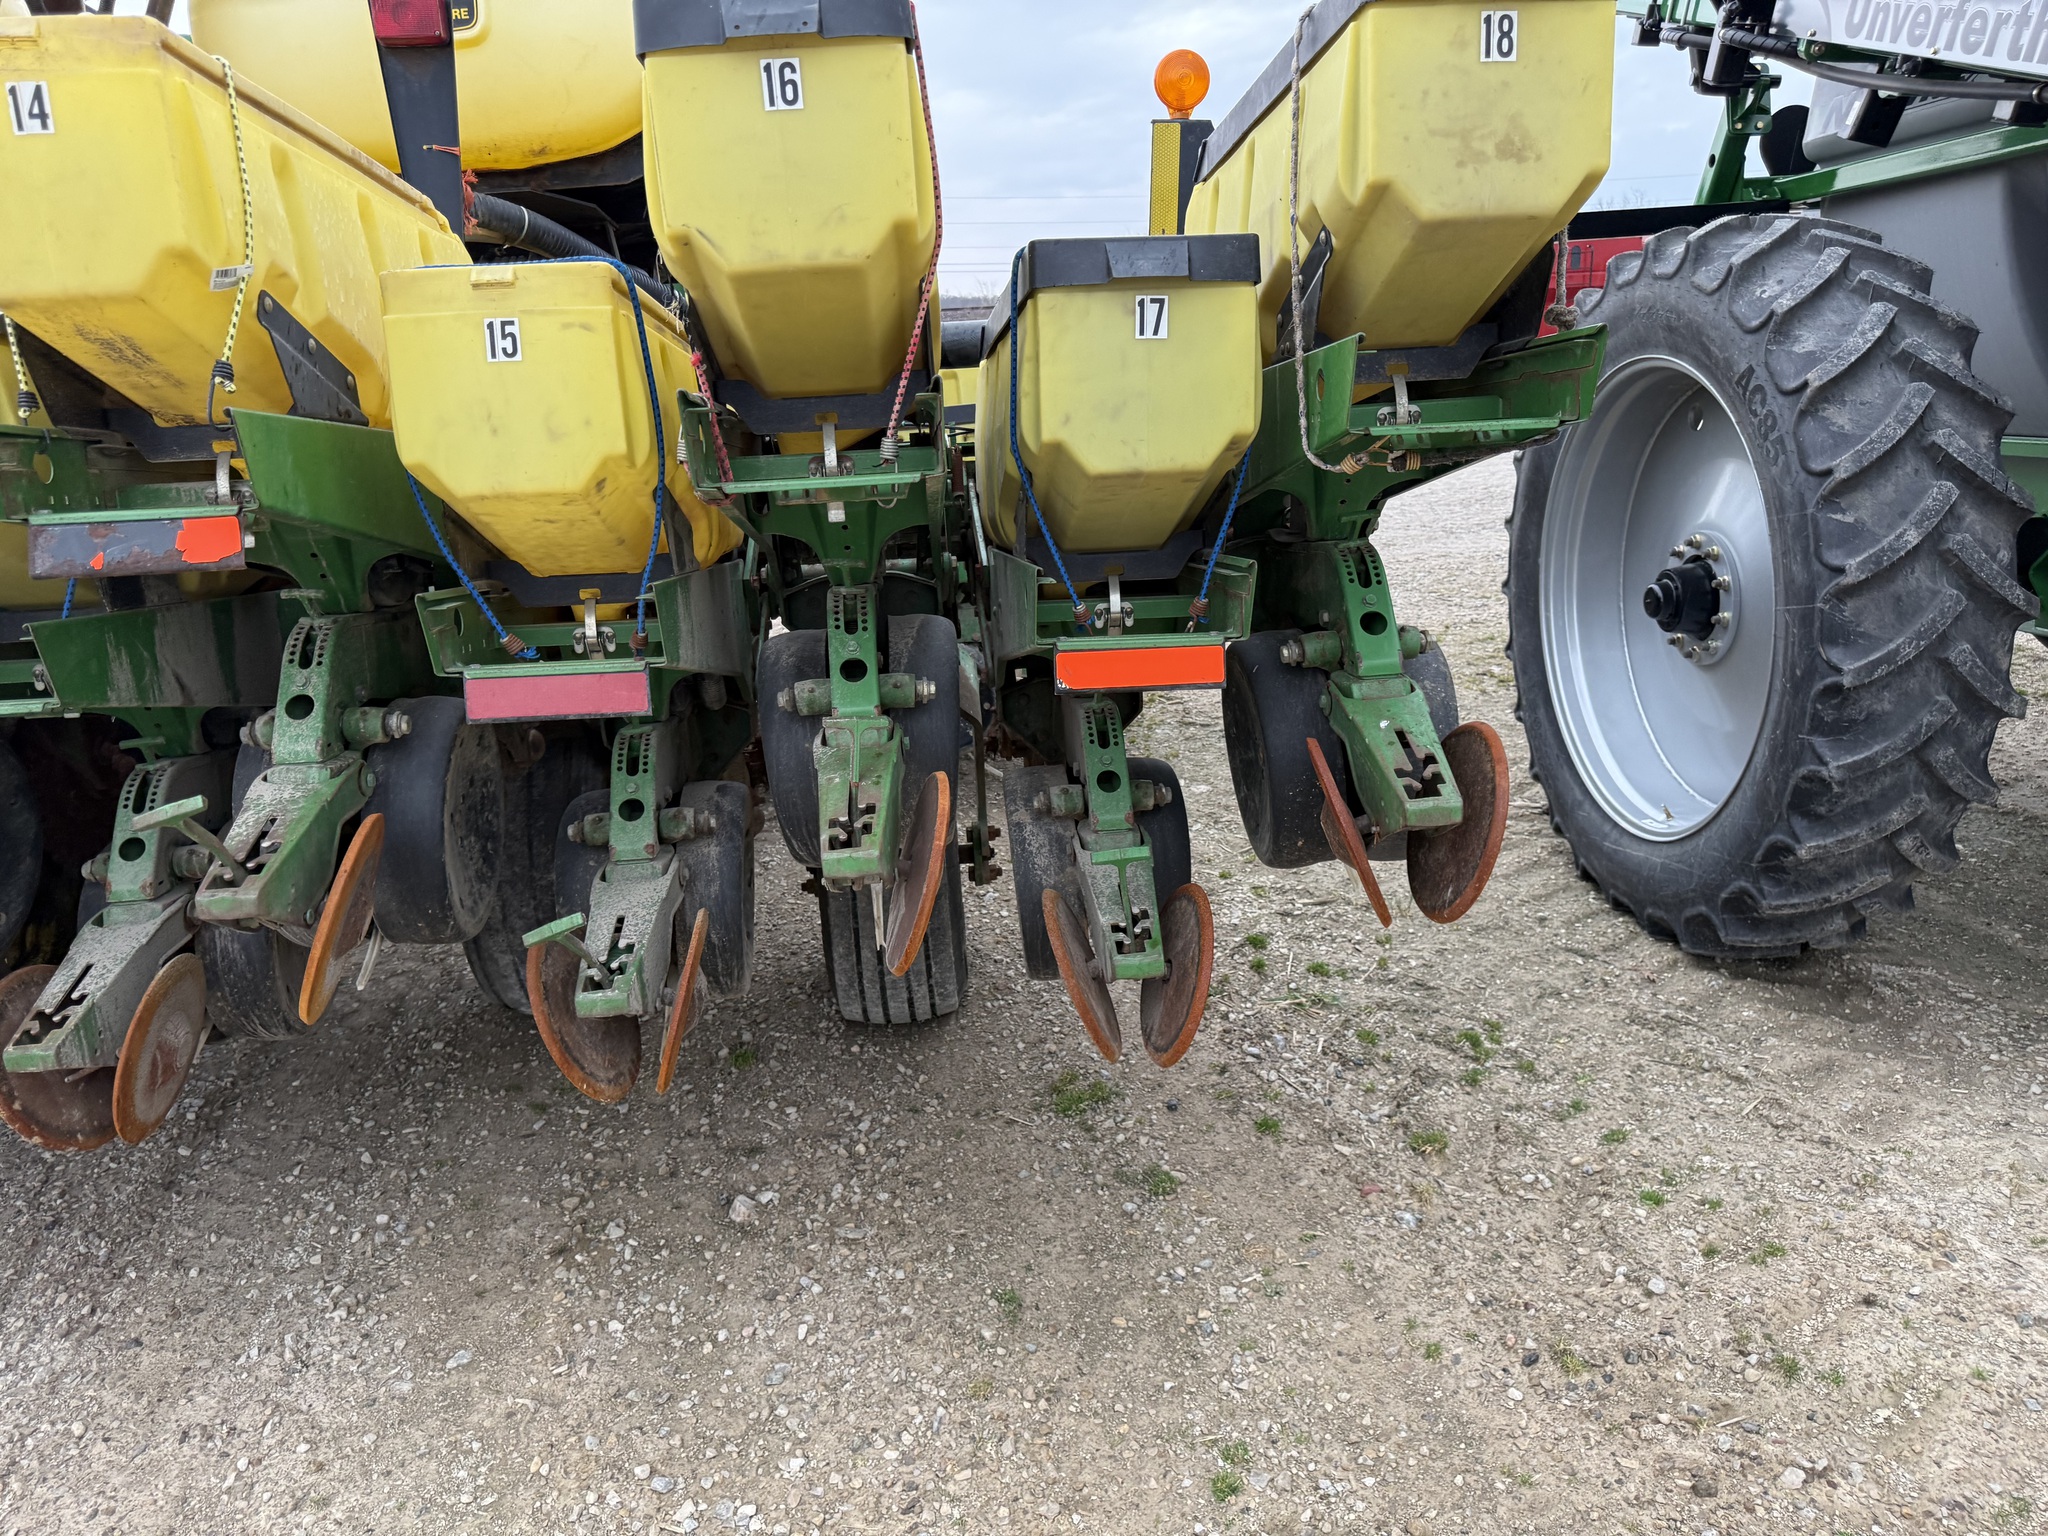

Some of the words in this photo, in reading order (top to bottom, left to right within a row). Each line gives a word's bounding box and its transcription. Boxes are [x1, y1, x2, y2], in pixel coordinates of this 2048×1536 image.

[1483, 13, 1514, 58] 18
[763, 61, 799, 107] 16
[8, 84, 50, 132] 14
[1137, 297, 1166, 336] 17
[486, 320, 518, 360] 15
[1734, 364, 1788, 467] AC85
